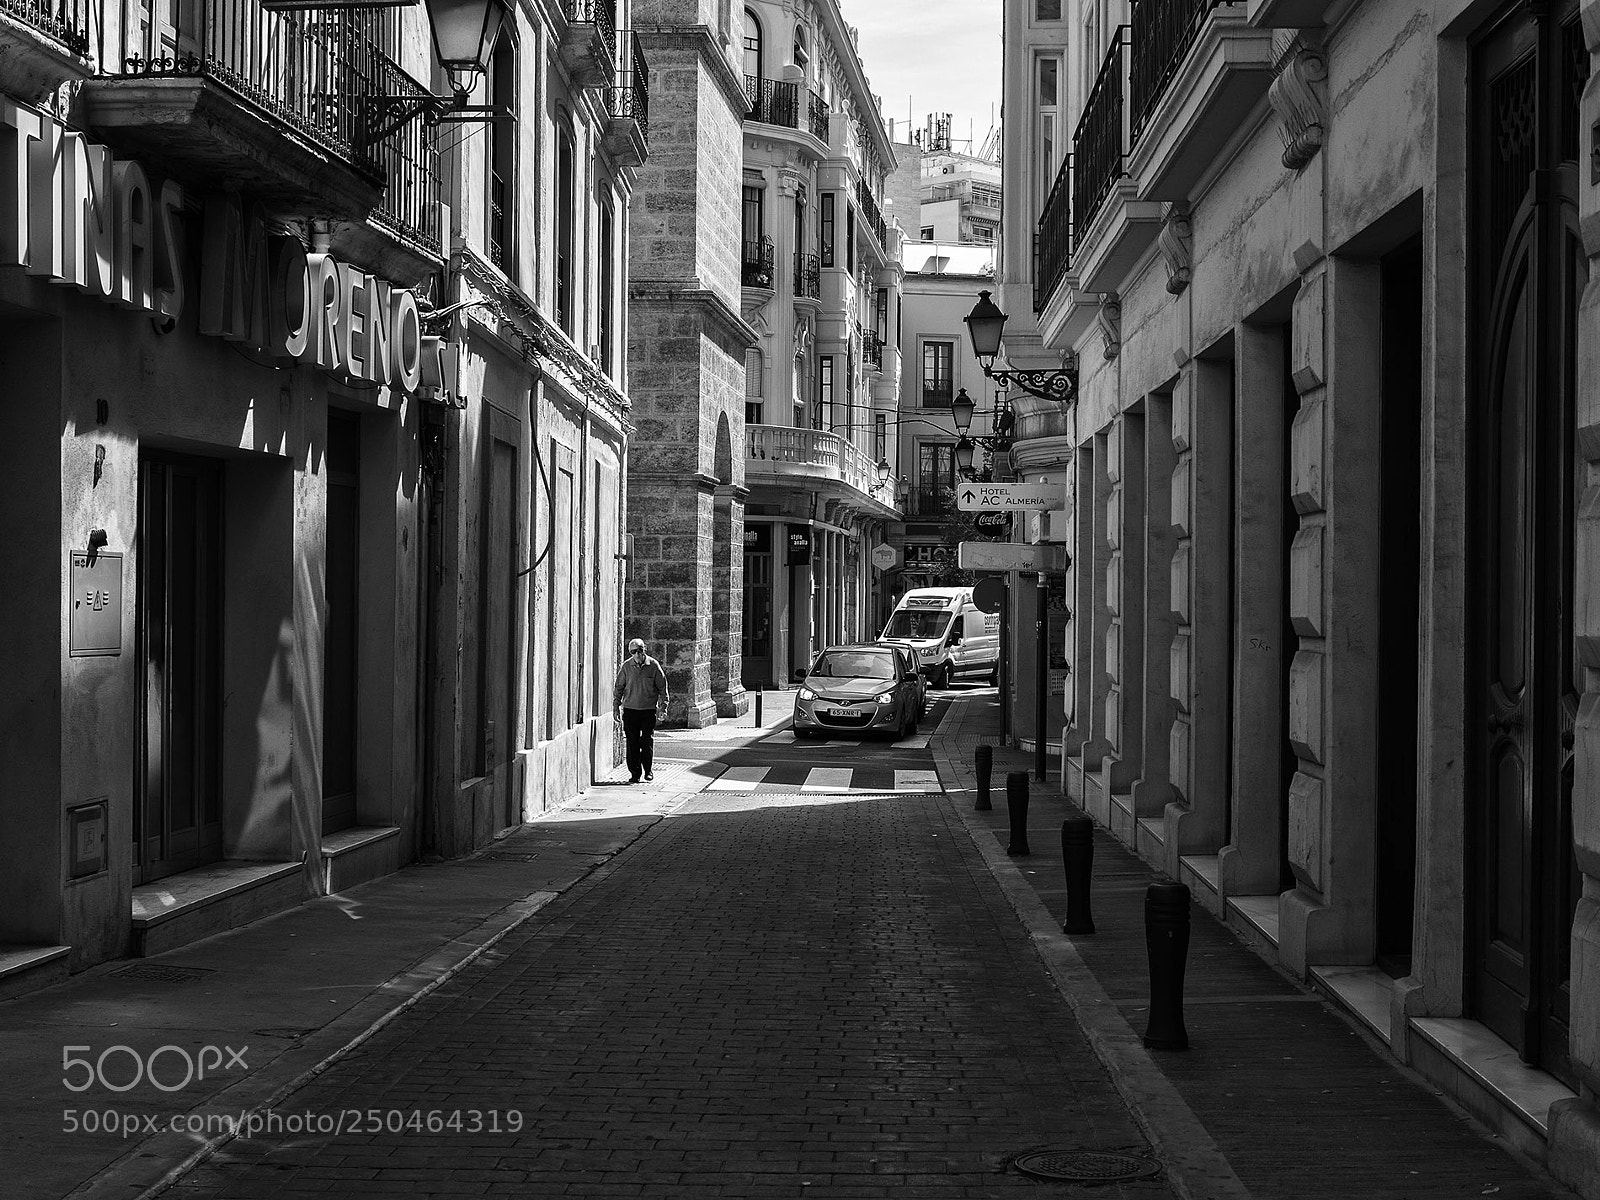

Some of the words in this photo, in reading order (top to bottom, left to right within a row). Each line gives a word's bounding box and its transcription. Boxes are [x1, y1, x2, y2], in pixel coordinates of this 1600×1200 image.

[206, 187, 421, 394] MORENO
[96, 398, 109, 426] 10
[980, 496, 1000, 506] AC
